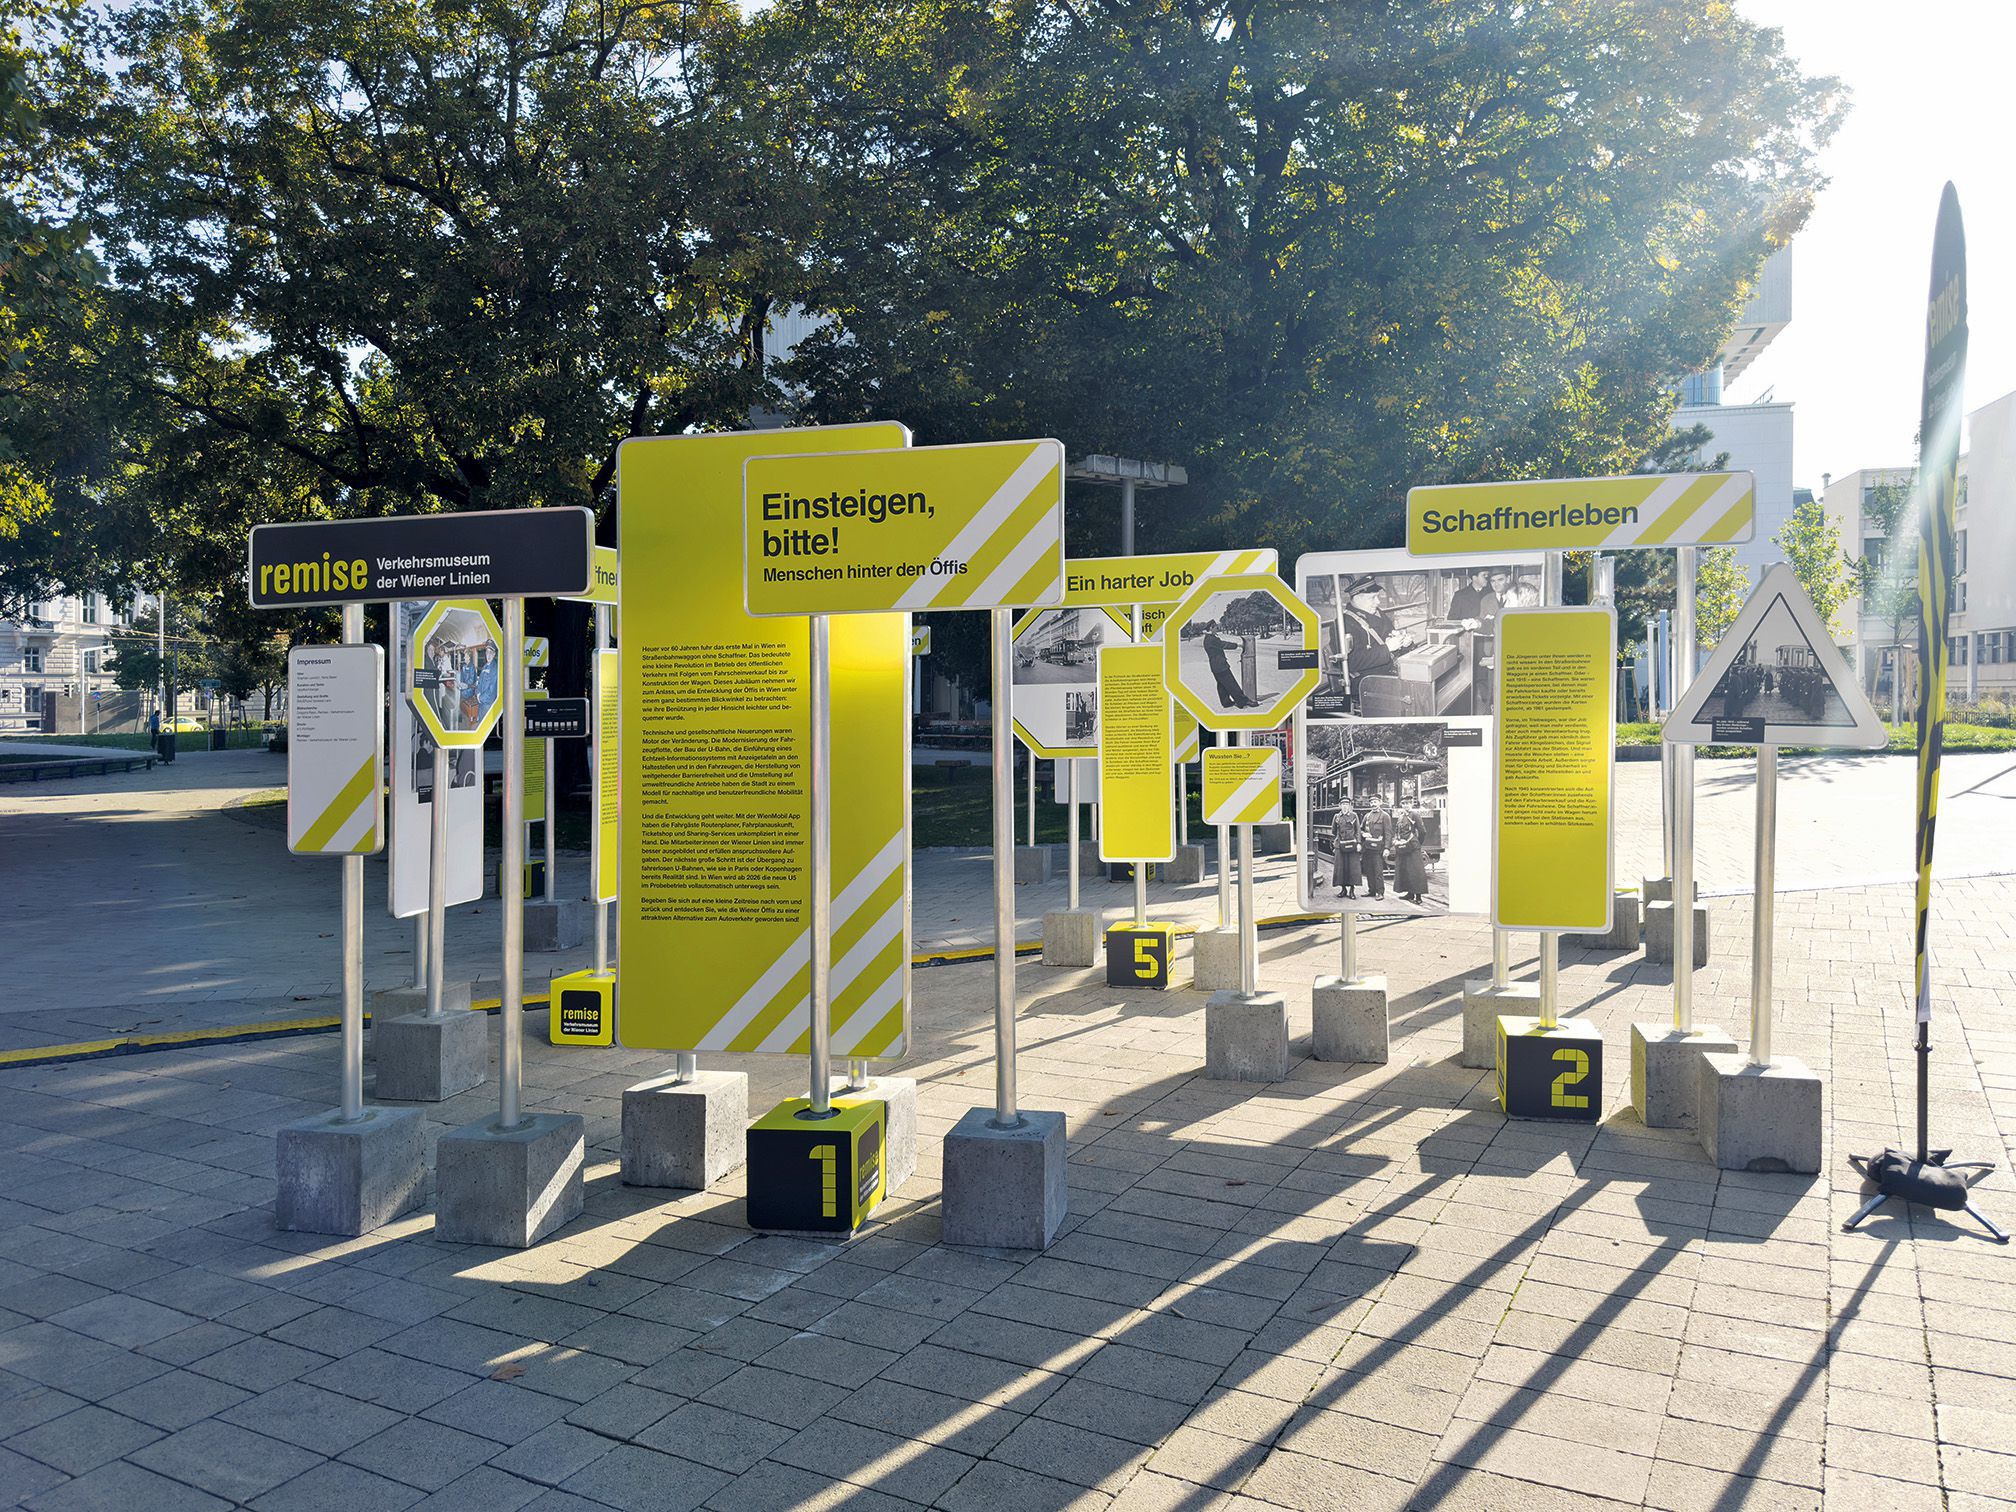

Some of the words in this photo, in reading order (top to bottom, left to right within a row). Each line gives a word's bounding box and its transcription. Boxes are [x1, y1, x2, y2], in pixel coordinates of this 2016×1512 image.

[763, 489, 935, 523] Einsteigen,
[1422, 502, 1638, 534] Schaffnerleben
[763, 527, 838, 557] bitte!
[261, 552, 368, 595] remise
[377, 553, 490, 571] Verkehrsmuseum
[764, 566, 843, 582] Menschen
[848, 563, 892, 579] hinter
[896, 562, 925, 578] den
[930, 557, 968, 576] Öffis
[377, 574, 398, 589] der
[401, 573, 446, 588] Wiener
[450, 571, 490, 586] Linien
[1067, 574, 1095, 592] Ein
[1101, 572, 1154, 590] harter
[1160, 570, 1194, 588] Job
[297, 658, 331, 666] Impressum
[737, 728, 773, 736] Neuerungen
[738, 754, 777, 762] Anzeigetafeln
[1425, 745, 1437, 757] 43
[1134, 938, 1159, 979] 5
[564, 1008, 598, 1020] remise
[1551, 1048, 1590, 1109] 2
[808, 1144, 837, 1218] 1
